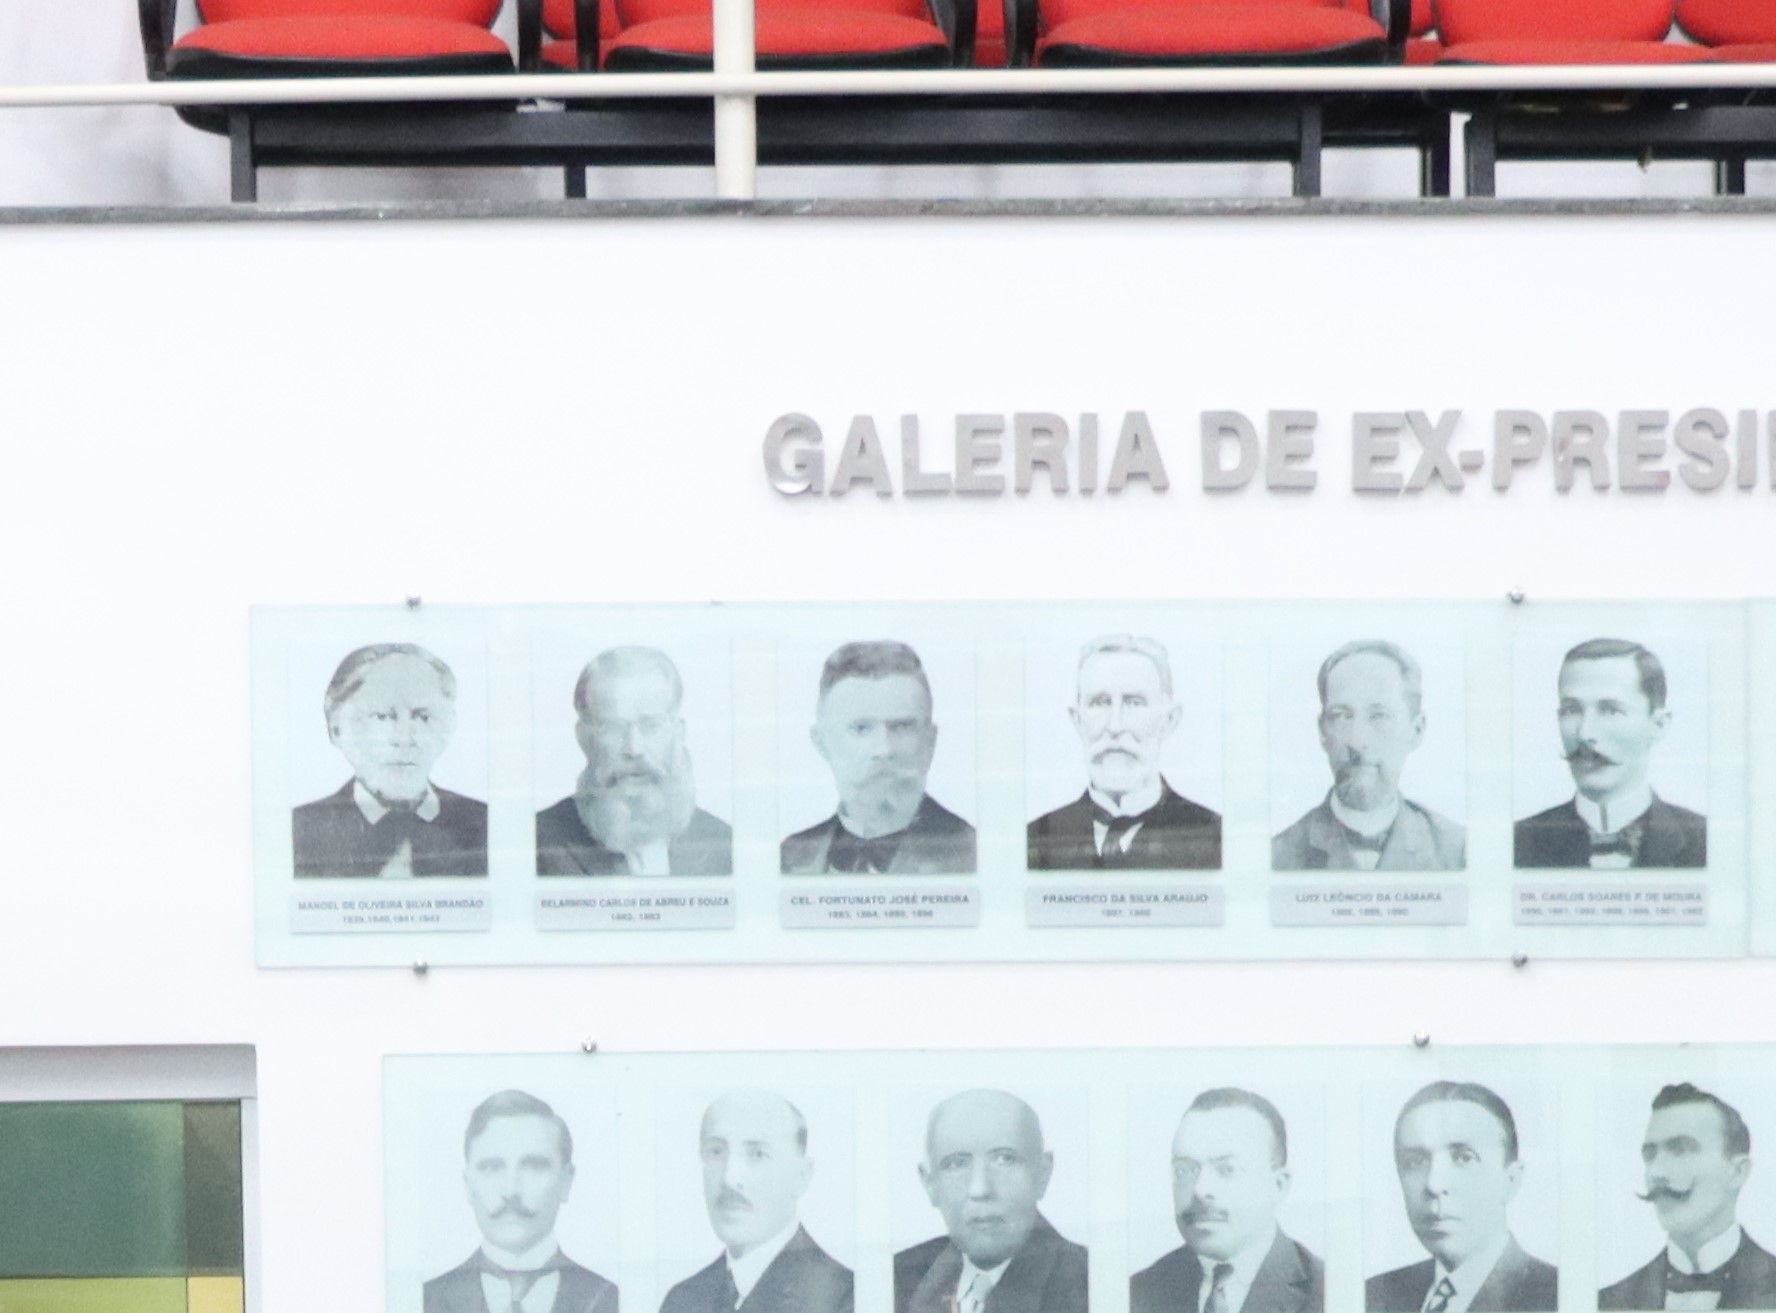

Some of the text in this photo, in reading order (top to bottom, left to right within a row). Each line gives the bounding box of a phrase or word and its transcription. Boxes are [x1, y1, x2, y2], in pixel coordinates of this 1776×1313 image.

[762, 410, 1170, 497] GALERIA
[1200, 409, 1318, 495] DE
[819, 896, 886, 905] FORTUNATO
[890, 895, 917, 904] JOSÉ
[922, 895, 970, 903] PEREIRA
[1043, 895, 1108, 903] FRANCISCO
[1111, 894, 1126, 902] DA
[1130, 894, 1159, 903] SILVA
[1376, 893, 1391, 901] DA
[298, 901, 340, 910] MANOEL
[599, 899, 637, 907] CARLOS
